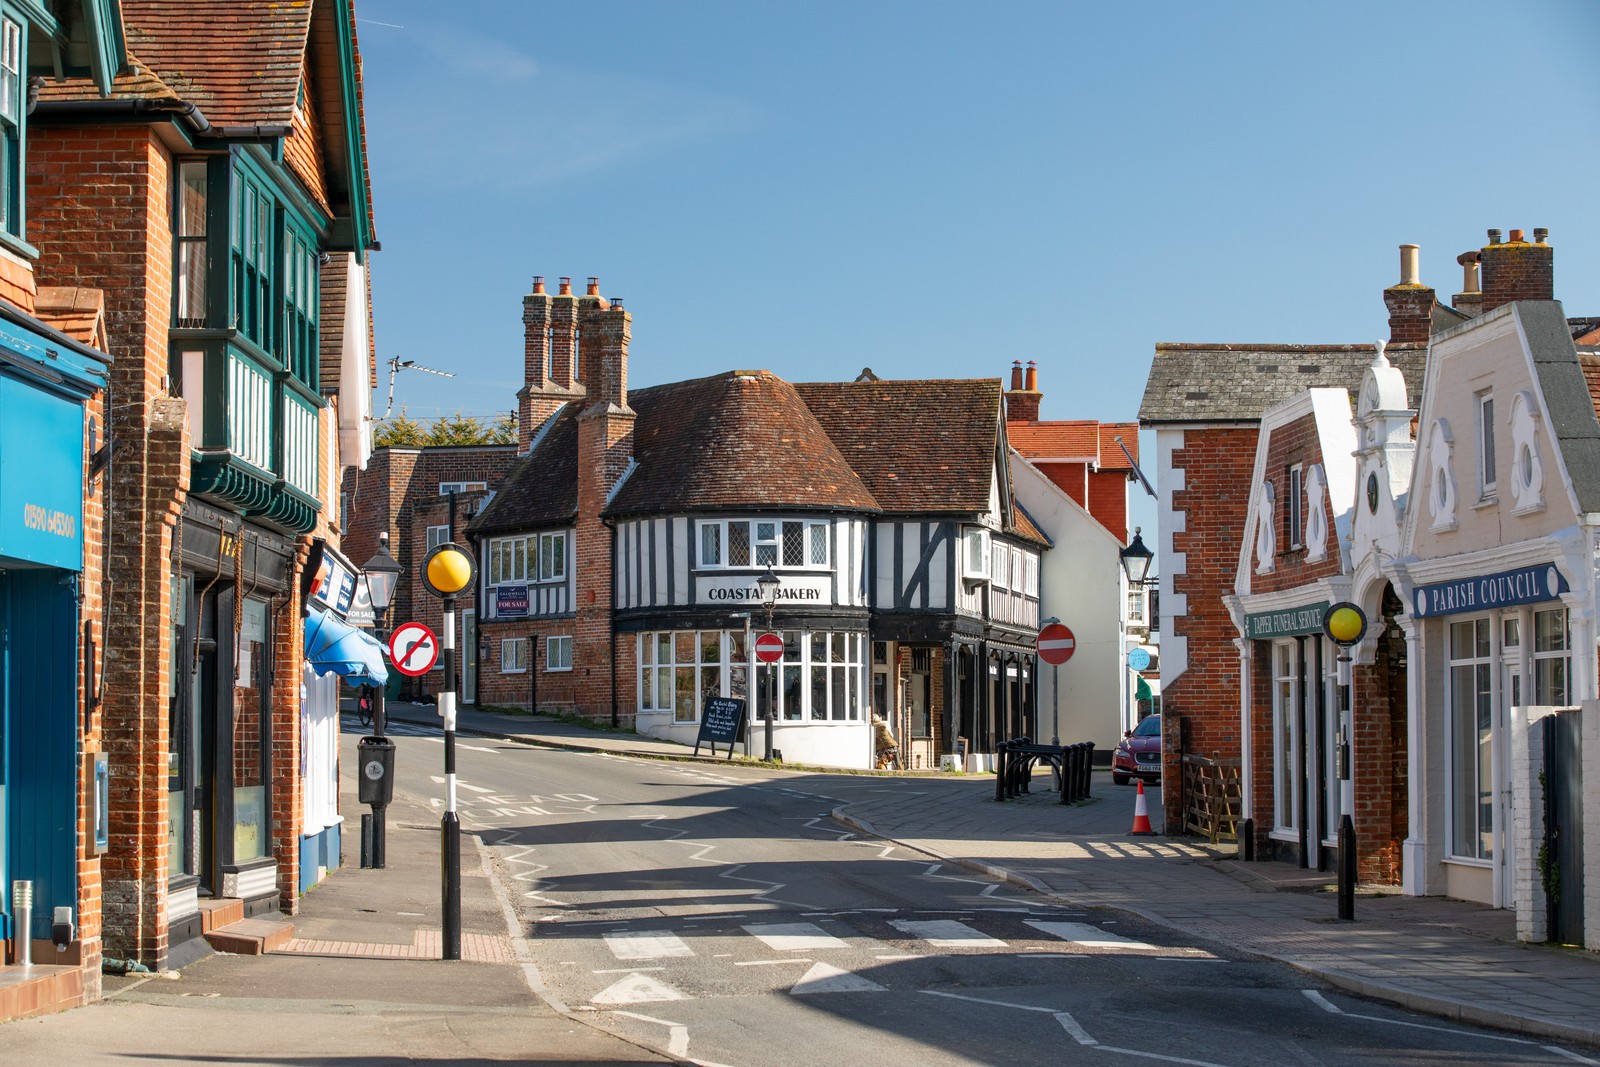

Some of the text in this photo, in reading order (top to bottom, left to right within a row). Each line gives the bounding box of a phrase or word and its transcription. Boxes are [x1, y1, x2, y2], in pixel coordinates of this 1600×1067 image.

[24, 503, 47, 532] 01590
[1433, 571, 1540, 612] PARISH COUNCIL
[348, 610, 360, 618] FOR
[1253, 608, 1322, 634] TAPPER FUNERAL SERVICE
[430, 794, 599, 807] AHEAD
[462, 805, 598, 818] ONLY
